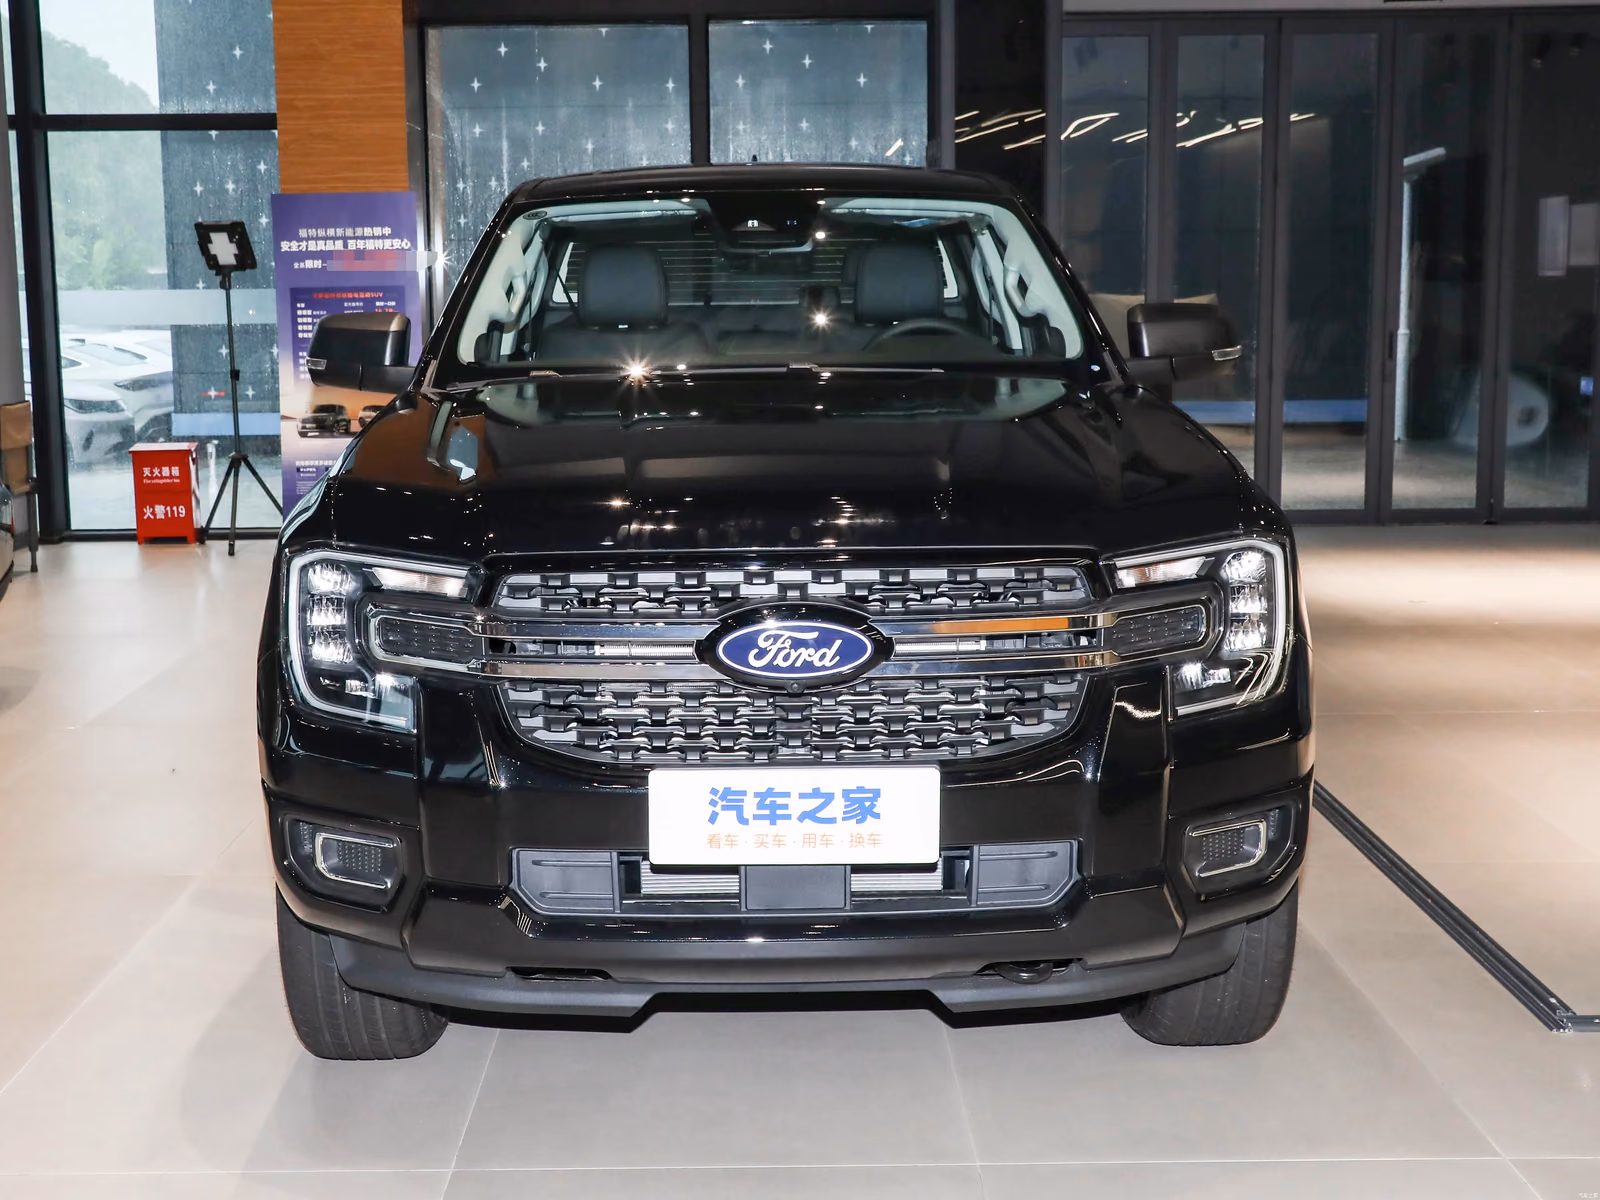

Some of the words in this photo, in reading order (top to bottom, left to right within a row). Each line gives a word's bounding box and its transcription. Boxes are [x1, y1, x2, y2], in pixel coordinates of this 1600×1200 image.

[143, 466, 180, 477] 灭火器箱
[143, 504, 186, 519] 火警119
[748, 629, 842, 668] Ford
[707, 786, 881, 826] 汽车之家
